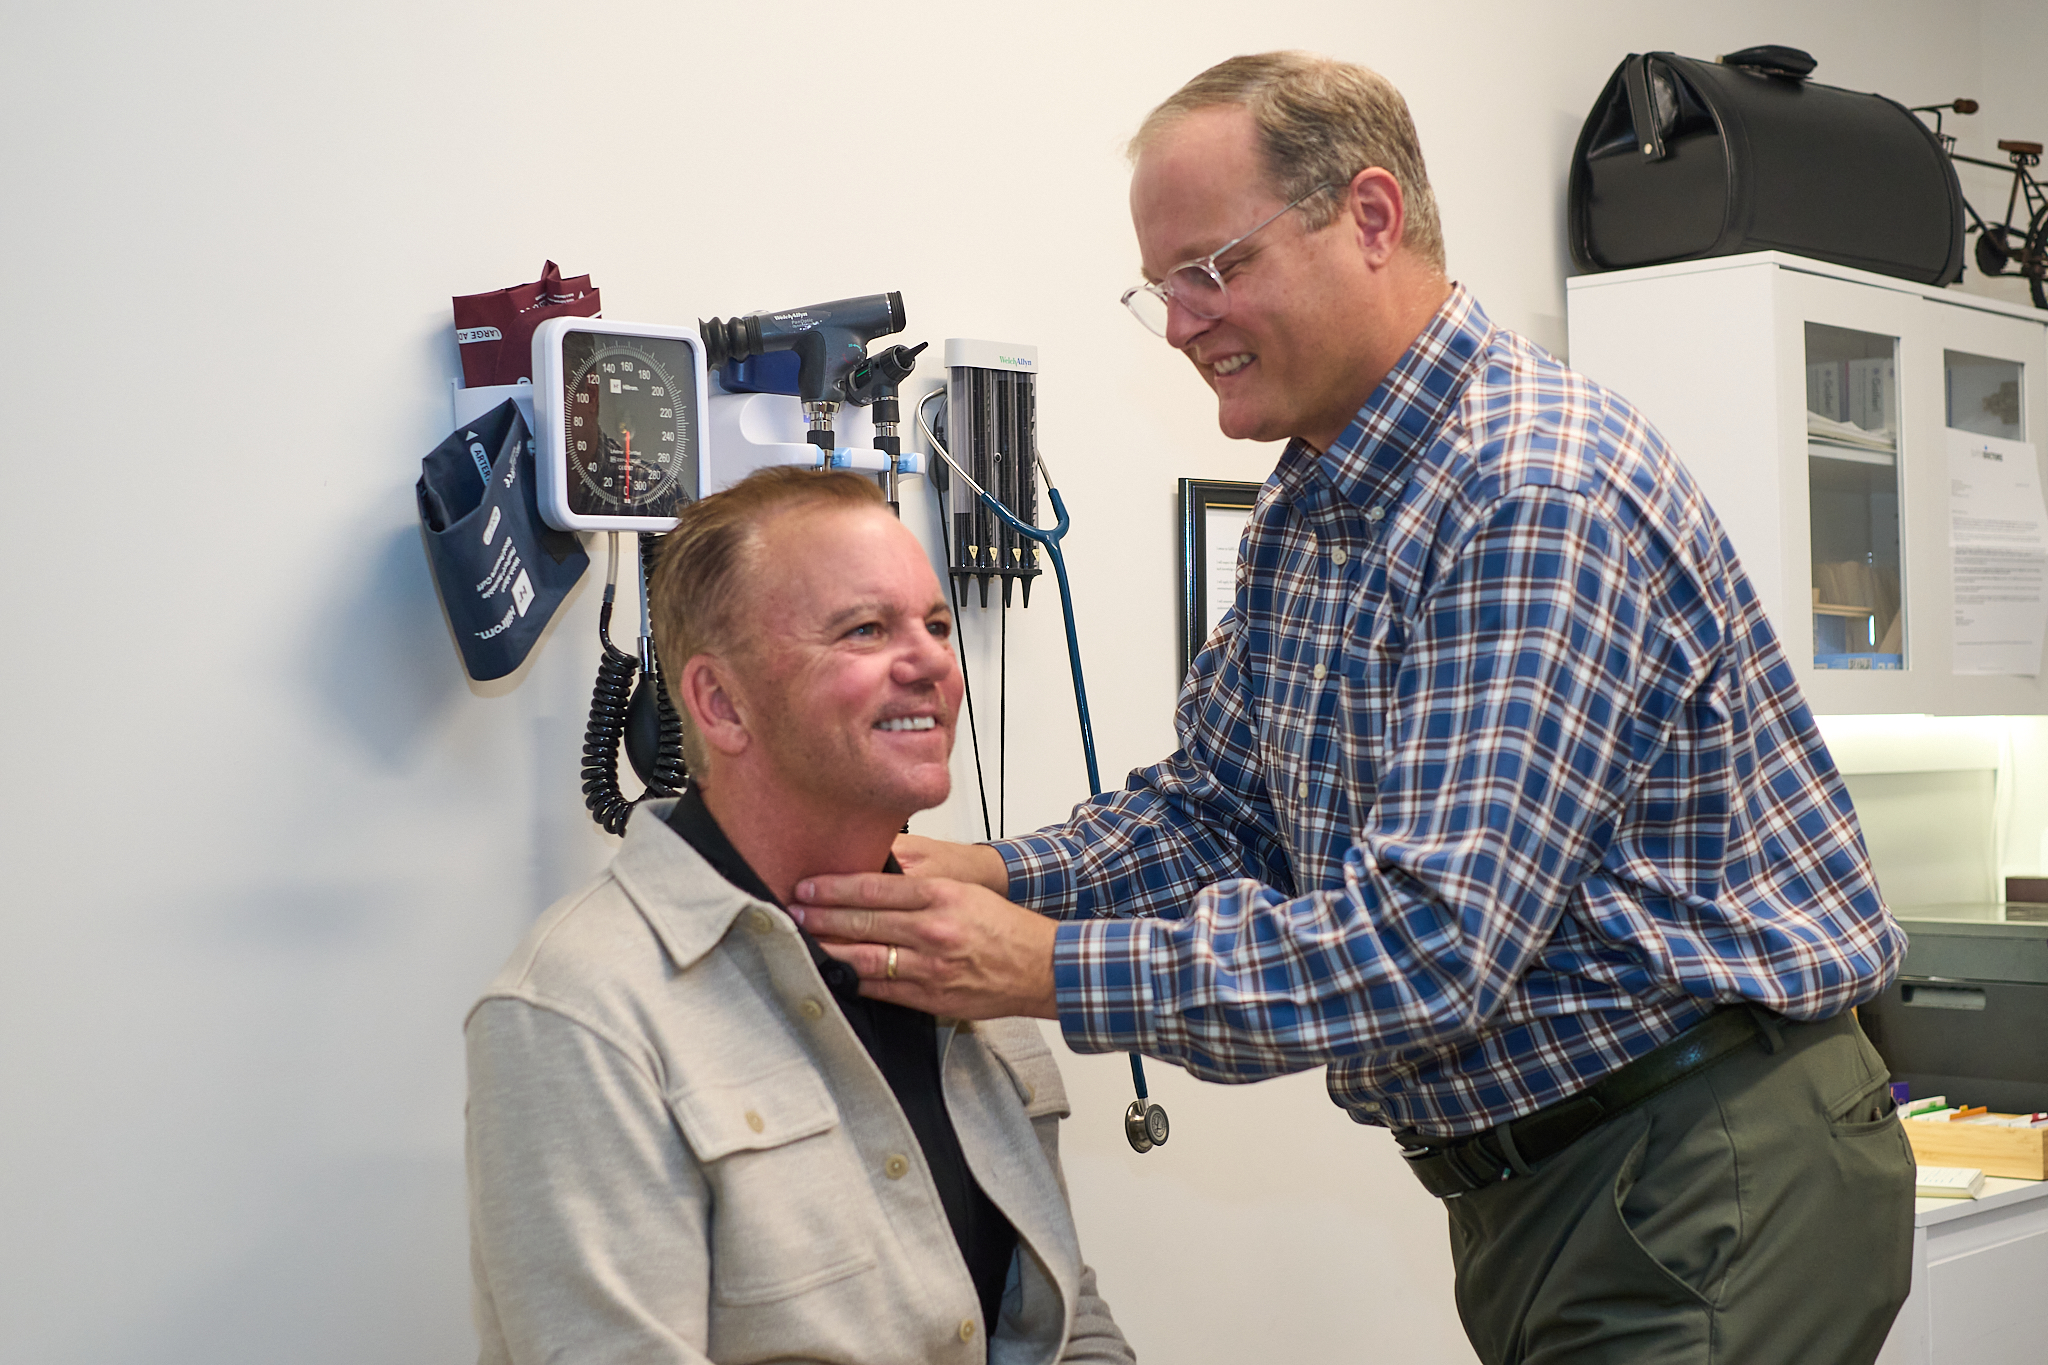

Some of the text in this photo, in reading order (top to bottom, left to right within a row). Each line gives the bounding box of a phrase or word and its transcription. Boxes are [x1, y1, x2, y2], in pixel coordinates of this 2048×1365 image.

[470, 329, 500, 339] LARGE
[602, 363, 616, 374] 140
[620, 361, 633, 372] 160
[587, 374, 600, 385] 120
[638, 369, 651, 380] 180
[651, 386, 664, 397] 200
[576, 393, 590, 404] 100
[660, 408, 672, 419] 220
[573, 416, 584, 427] 80
[662, 431, 675, 442] 240
[577, 441, 587, 452] 60
[658, 453, 671, 463] 260
[587, 462, 598, 472] 40
[648, 470, 661, 480] 280
[603, 477, 613, 487] 20
[634, 480, 647, 491] 300
